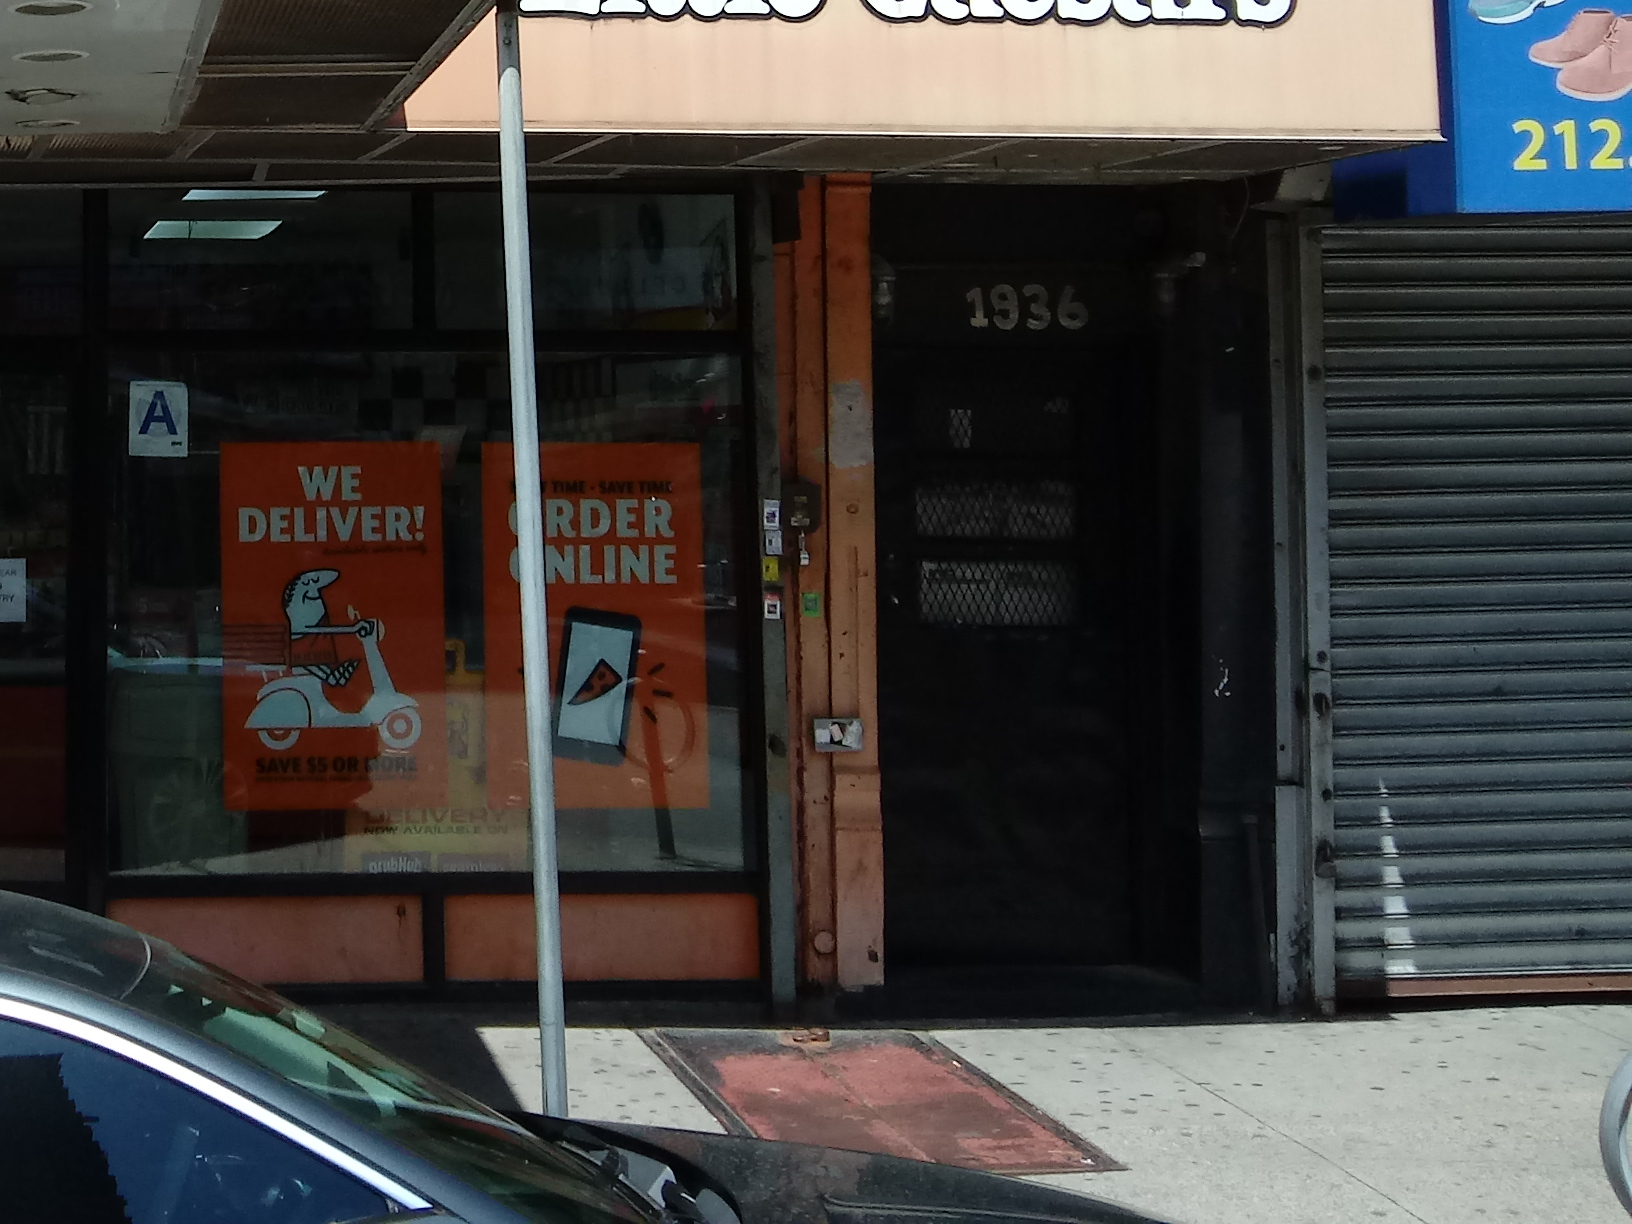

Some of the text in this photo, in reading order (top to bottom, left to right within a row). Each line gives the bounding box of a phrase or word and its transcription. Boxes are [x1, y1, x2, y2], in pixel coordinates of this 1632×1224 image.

[966, 283, 1089, 332] 1936
[138, 390, 178, 435] A
[297, 465, 363, 502] WE
[551, 479, 586, 494] TIME
[598, 479, 635, 494] SAVE
[238, 505, 425, 543] DELIVER!
[256, 756, 301, 774] SAVE
[307, 756, 328, 774] $5
[333, 756, 359, 773] OR
[403, 826, 480, 835] AVAILABLE
